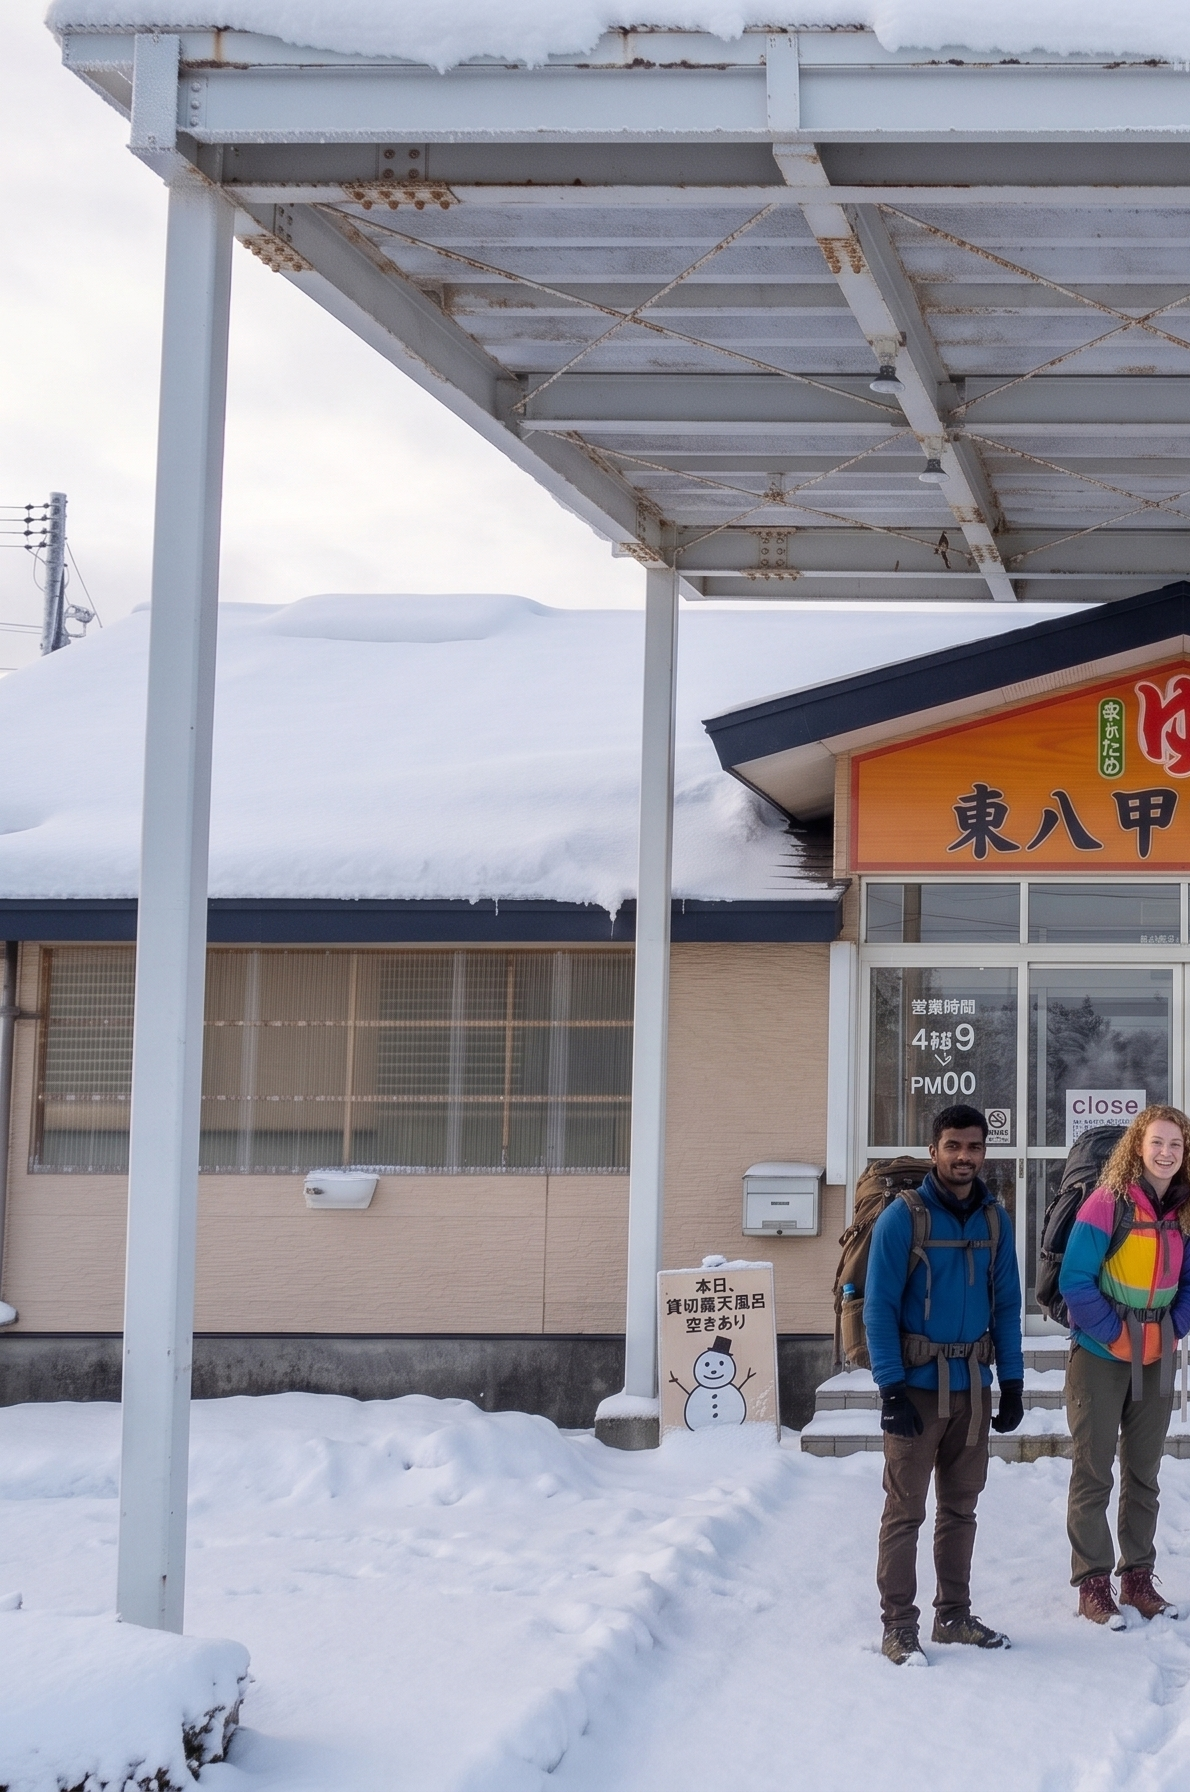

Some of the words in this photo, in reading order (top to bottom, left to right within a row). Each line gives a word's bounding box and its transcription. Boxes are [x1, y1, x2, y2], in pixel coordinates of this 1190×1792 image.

[911, 1071, 976, 1095] PM00
[1072, 1095, 1139, 1115] close
[695, 1277, 735, 1295] 本日、
[686, 1313, 746, 1334] 空きあり
